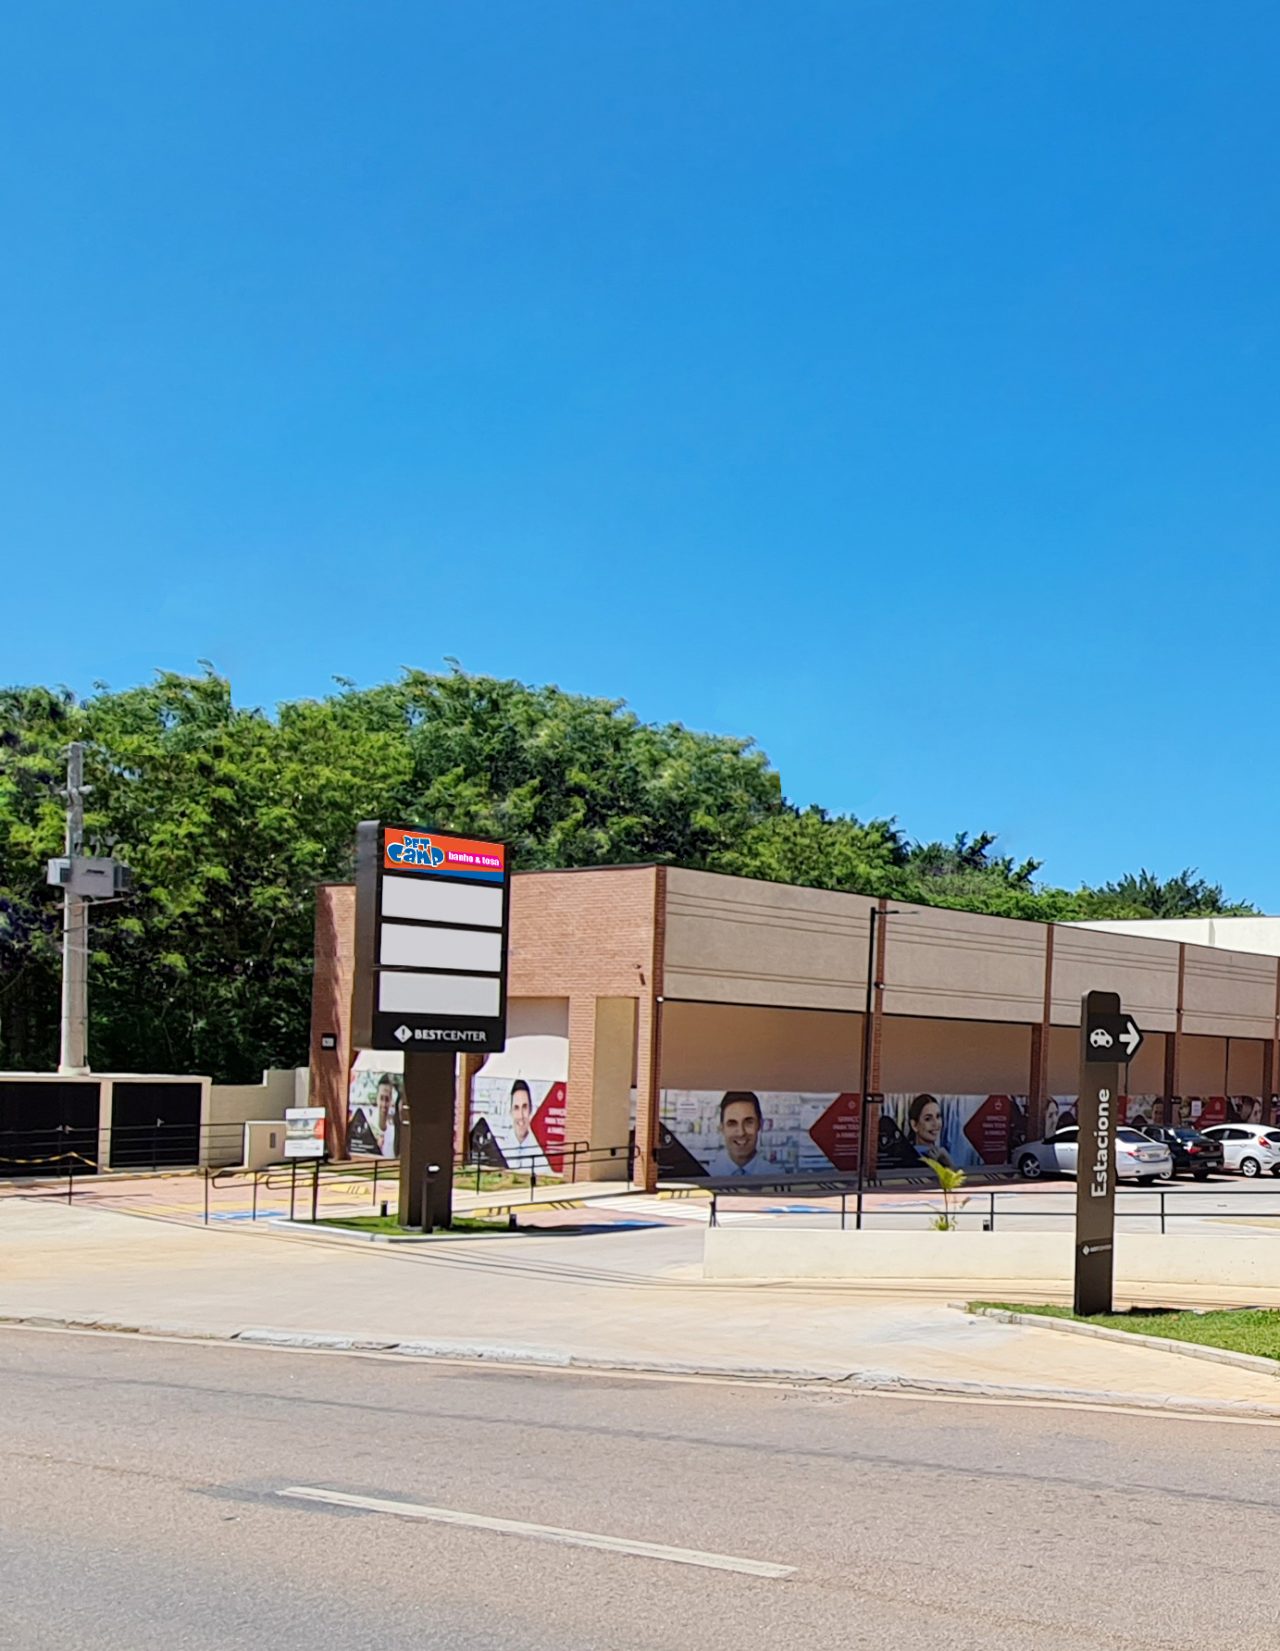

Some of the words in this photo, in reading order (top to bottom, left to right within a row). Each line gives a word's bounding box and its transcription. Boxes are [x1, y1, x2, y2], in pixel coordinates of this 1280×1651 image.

[403, 835, 430, 849] PET
[448, 851, 474, 863] banho
[475, 856, 481, 864] &
[482, 857, 500, 866] tosa
[414, 1029, 487, 1041] BESTCENTER
[1091, 1088, 1110, 1197] Estacione
